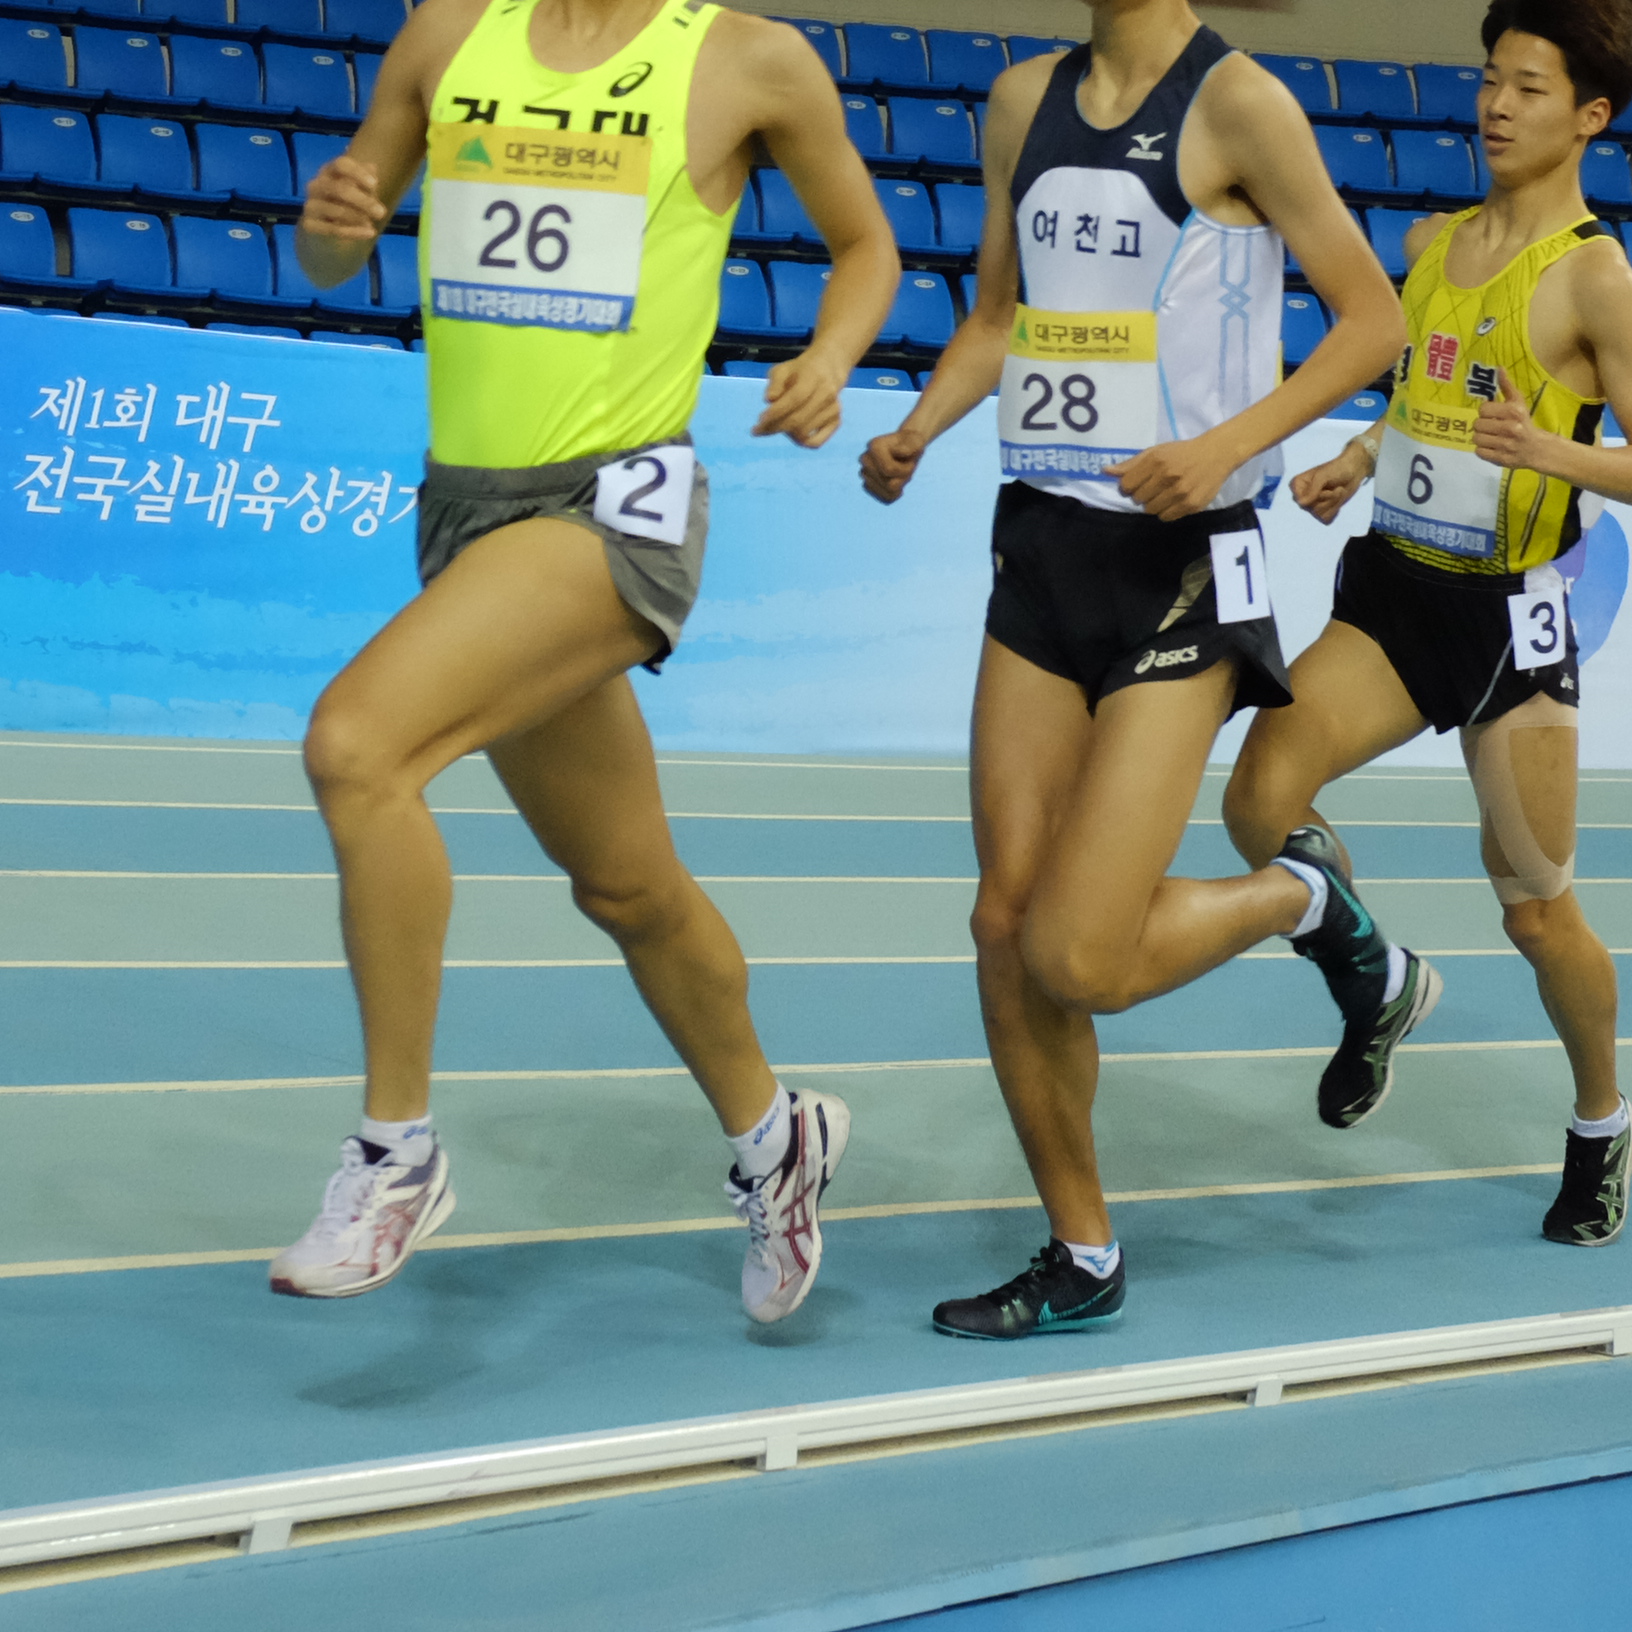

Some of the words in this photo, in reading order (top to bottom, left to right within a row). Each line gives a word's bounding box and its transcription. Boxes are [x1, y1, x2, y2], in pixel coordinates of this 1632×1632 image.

[505, 142, 621, 171] 대구광역시
[478, 200, 572, 272] 26
[1032, 209, 1141, 258] 여천고
[1035, 323, 1130, 345] 대구광역시
[30, 376, 158, 443] 제1회
[175, 381, 282, 452] 대구
[1020, 373, 1099, 432] 28
[618, 455, 667, 522] 2
[1406, 454, 1434, 505] 6
[1234, 545, 1253, 605] 1
[1529, 601, 1558, 654] 3
